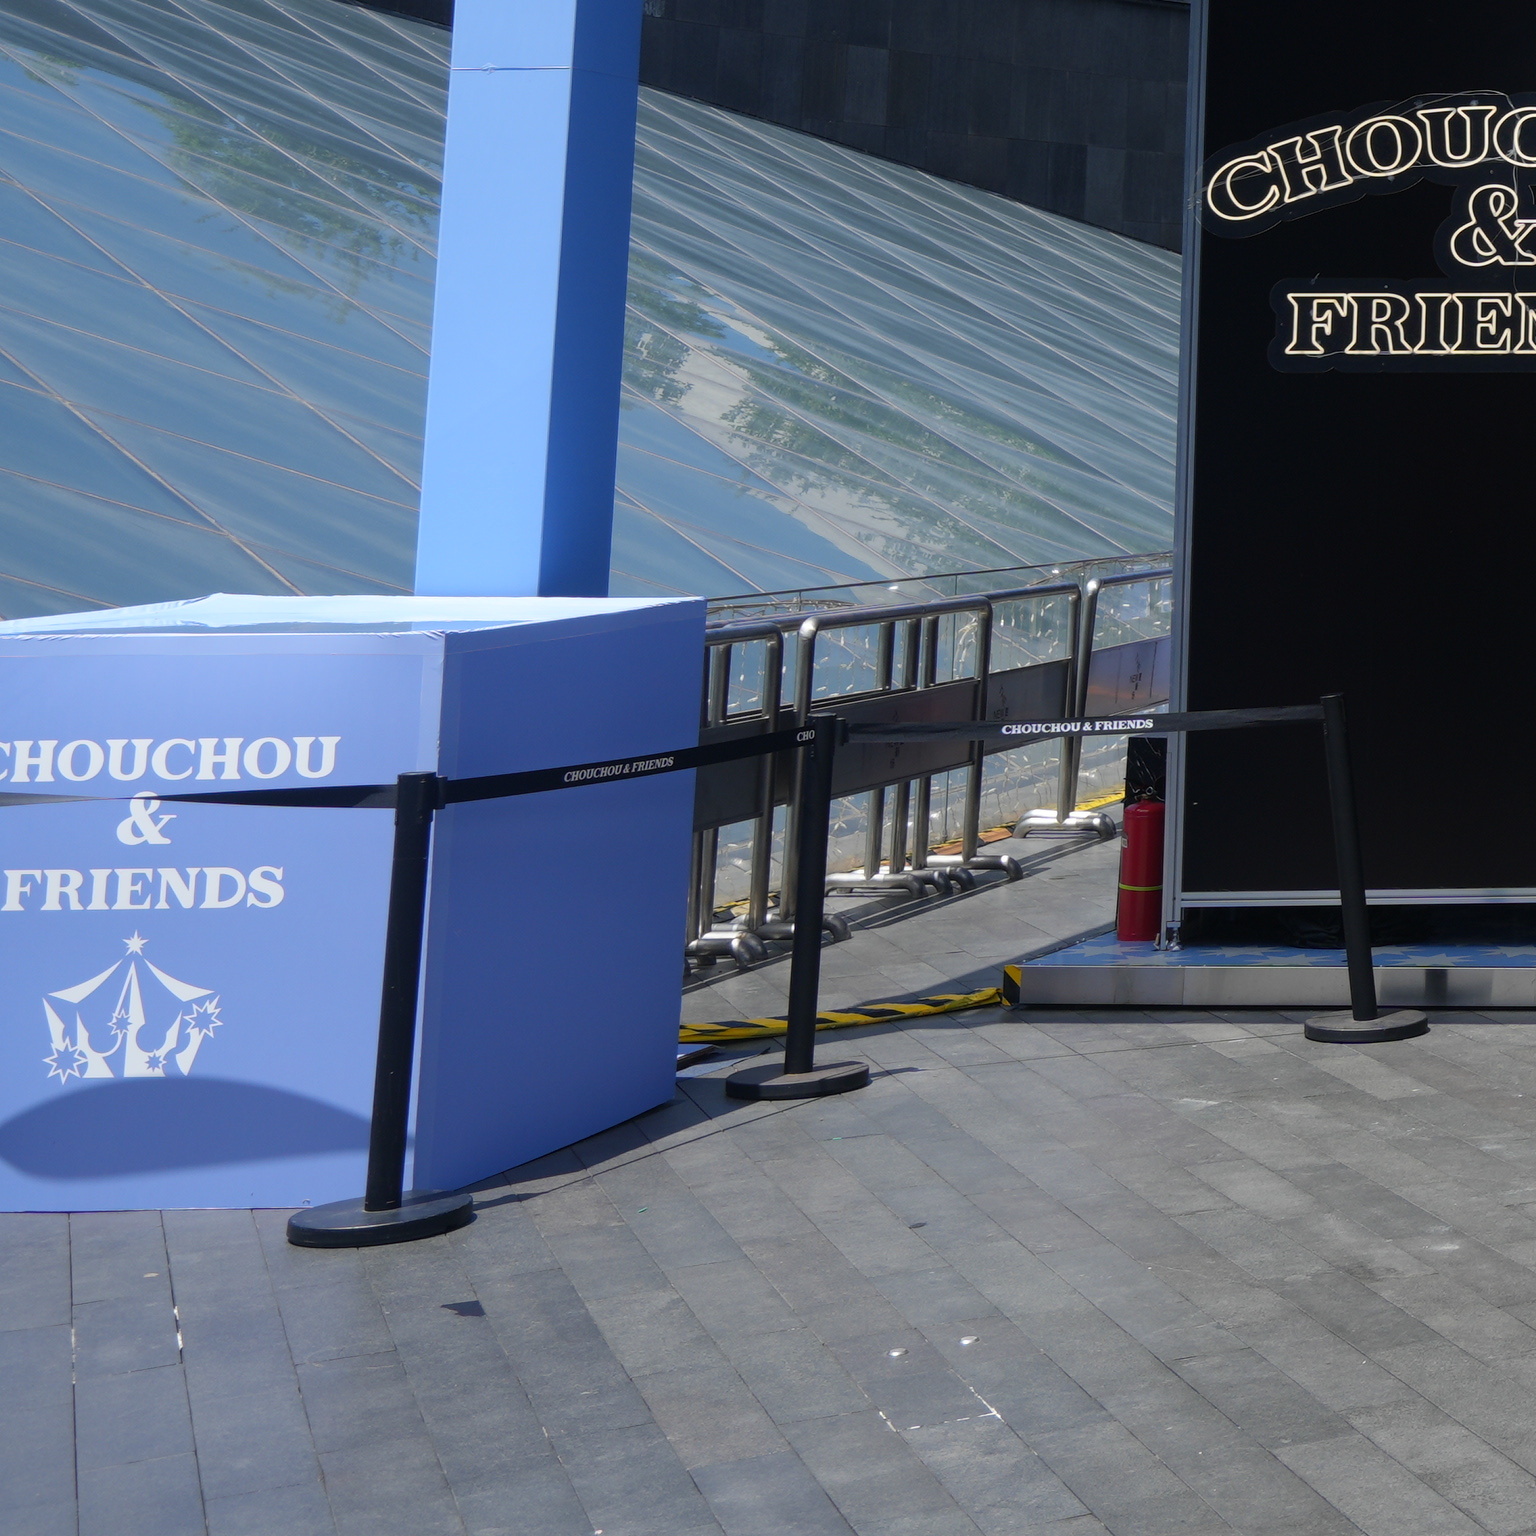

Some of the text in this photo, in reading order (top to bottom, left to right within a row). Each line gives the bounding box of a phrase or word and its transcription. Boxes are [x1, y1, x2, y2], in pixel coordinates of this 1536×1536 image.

[1001, 719, 1154, 735] CHOUCHOU & FRIENDS
[564, 756, 675, 782] CHOUCHOU & FRIENDS
[116, 791, 177, 846] &
[1, 866, 285, 911] FRIENDS
